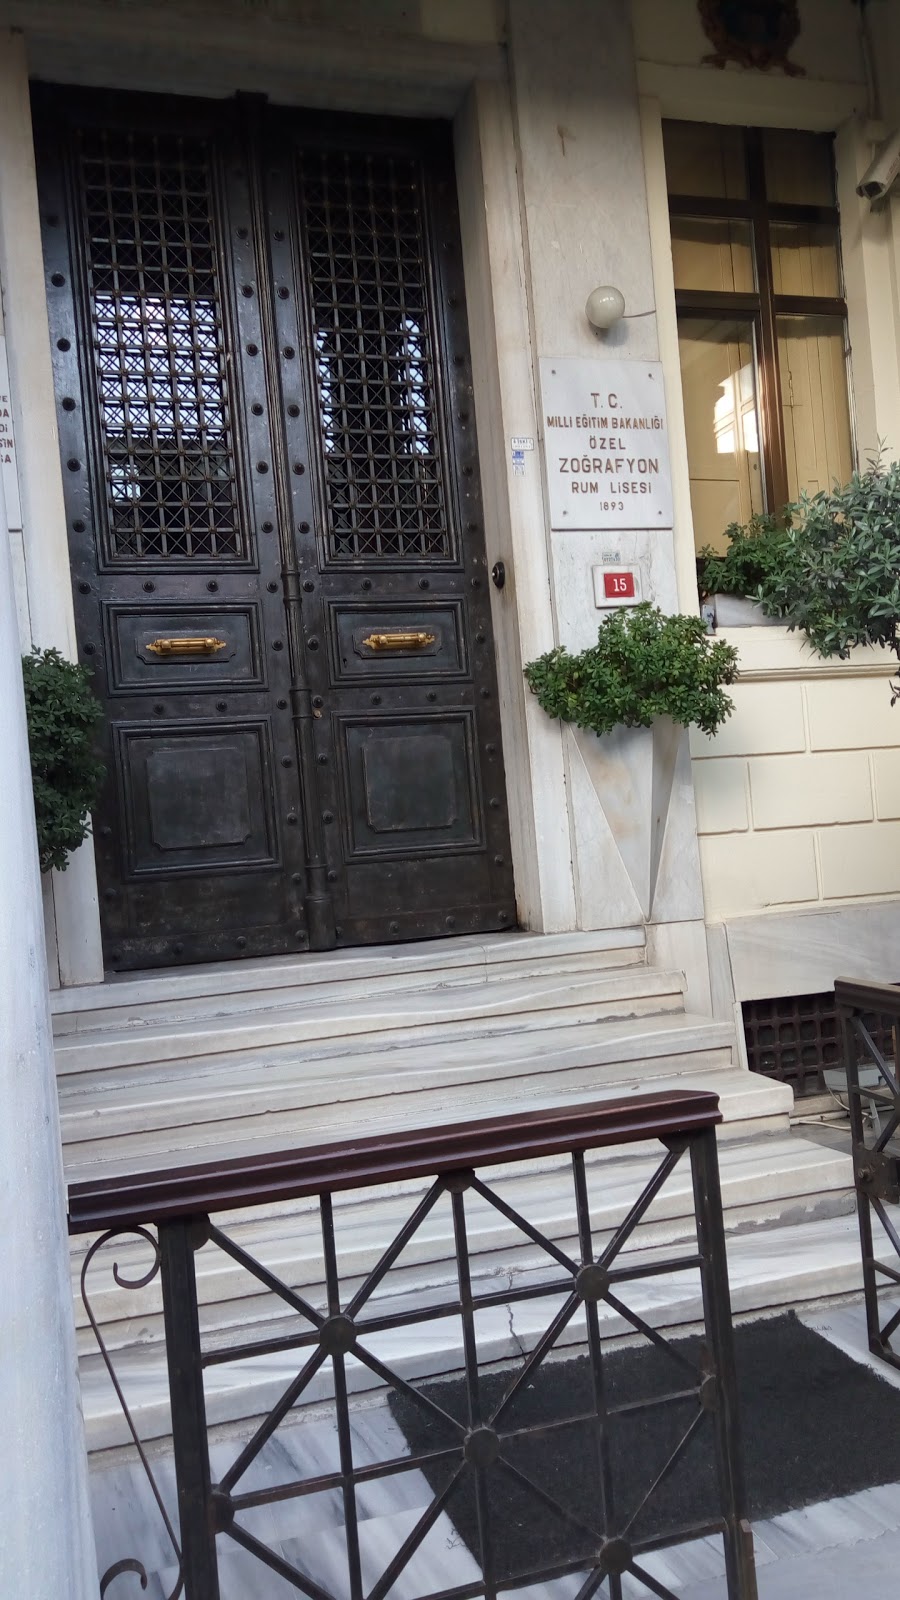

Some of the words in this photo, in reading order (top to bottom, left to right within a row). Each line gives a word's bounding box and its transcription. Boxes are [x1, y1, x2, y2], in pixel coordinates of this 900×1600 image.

[0, 395, 8, 403] E
[546, 415, 573, 428] MİLLİ
[575, 414, 608, 429] EĞİTİM
[611, 415, 664, 430] BAKANLIĞI
[589, 435, 627, 450] ÖZEL
[558, 454, 660, 474] ZOĞRAFYON
[571, 481, 599, 494] RUM
[610, 481, 652, 494] LİSESİ
[599, 501, 624, 511] 1893
[612, 577, 627, 592] 15
